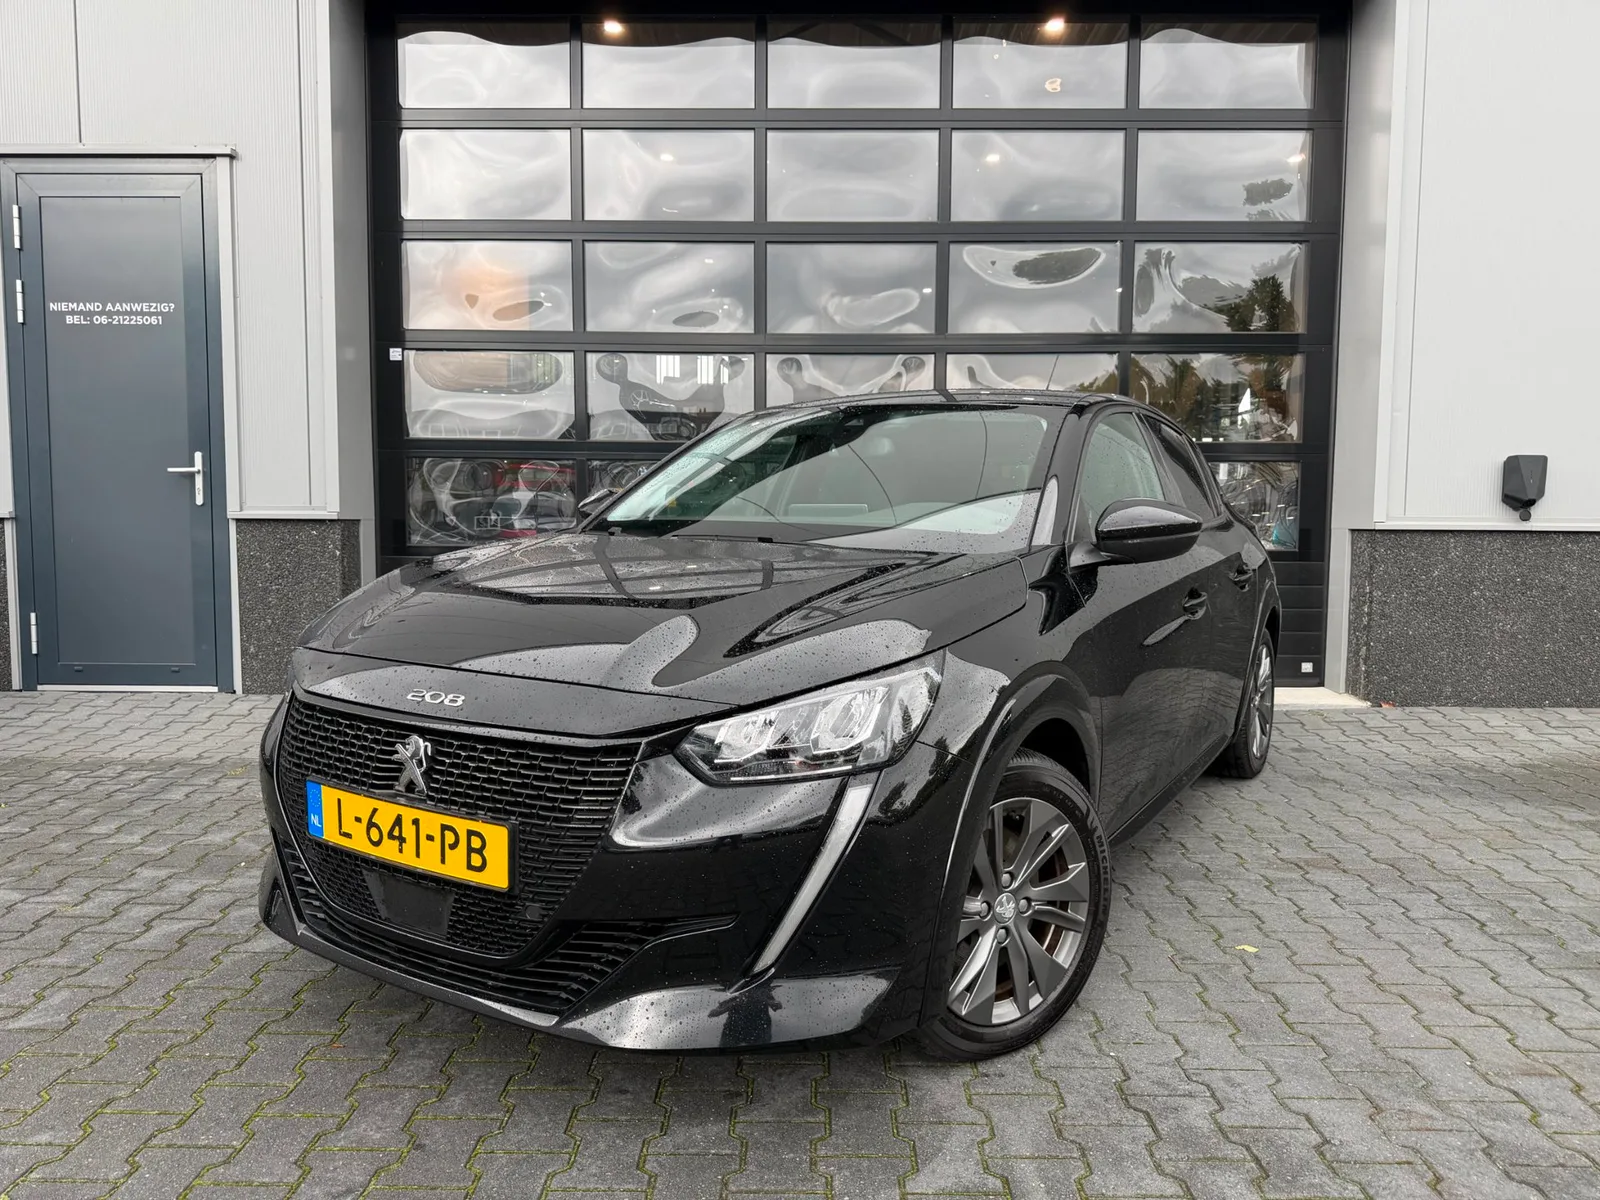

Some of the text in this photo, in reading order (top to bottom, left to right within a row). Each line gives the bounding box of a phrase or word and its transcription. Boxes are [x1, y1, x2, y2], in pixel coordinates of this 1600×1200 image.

[49, 302, 175, 312] NIEMAND AANWEZIG?
[65, 315, 163, 325] BEL: 06-21225061
[406, 688, 466, 707] 208
[310, 813, 322, 828] NL
[337, 798, 488, 873] L-641-PB
[1095, 835, 1109, 915] MICHELIN
